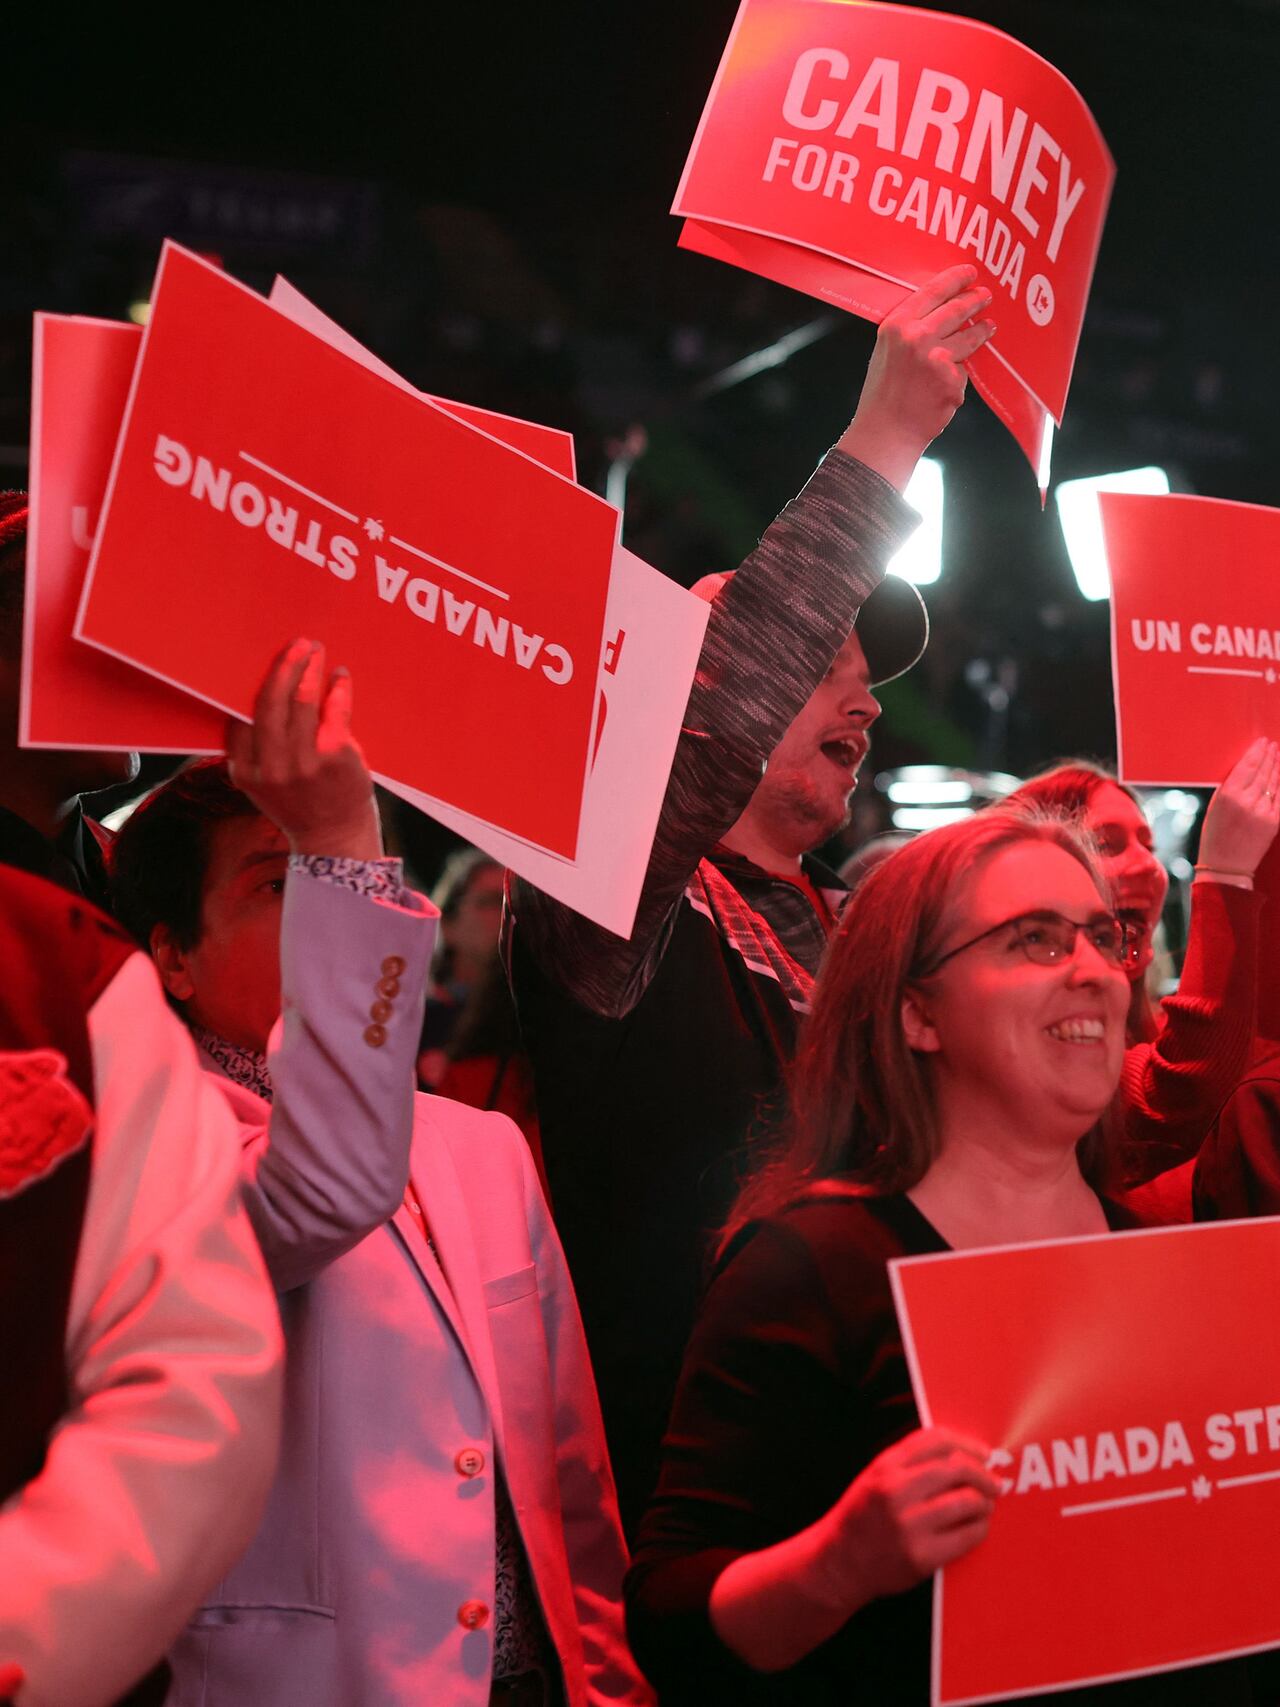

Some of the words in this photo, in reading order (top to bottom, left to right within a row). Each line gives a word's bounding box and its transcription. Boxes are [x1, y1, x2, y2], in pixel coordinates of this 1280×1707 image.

[762, 137, 861, 204] FOR
[868, 165, 1026, 300] CANADA
[781, 47, 1085, 263] CARNEY
[154, 434, 360, 581] STRONG
[375, 554, 575, 685] CANADA
[1131, 619, 1181, 653] UN
